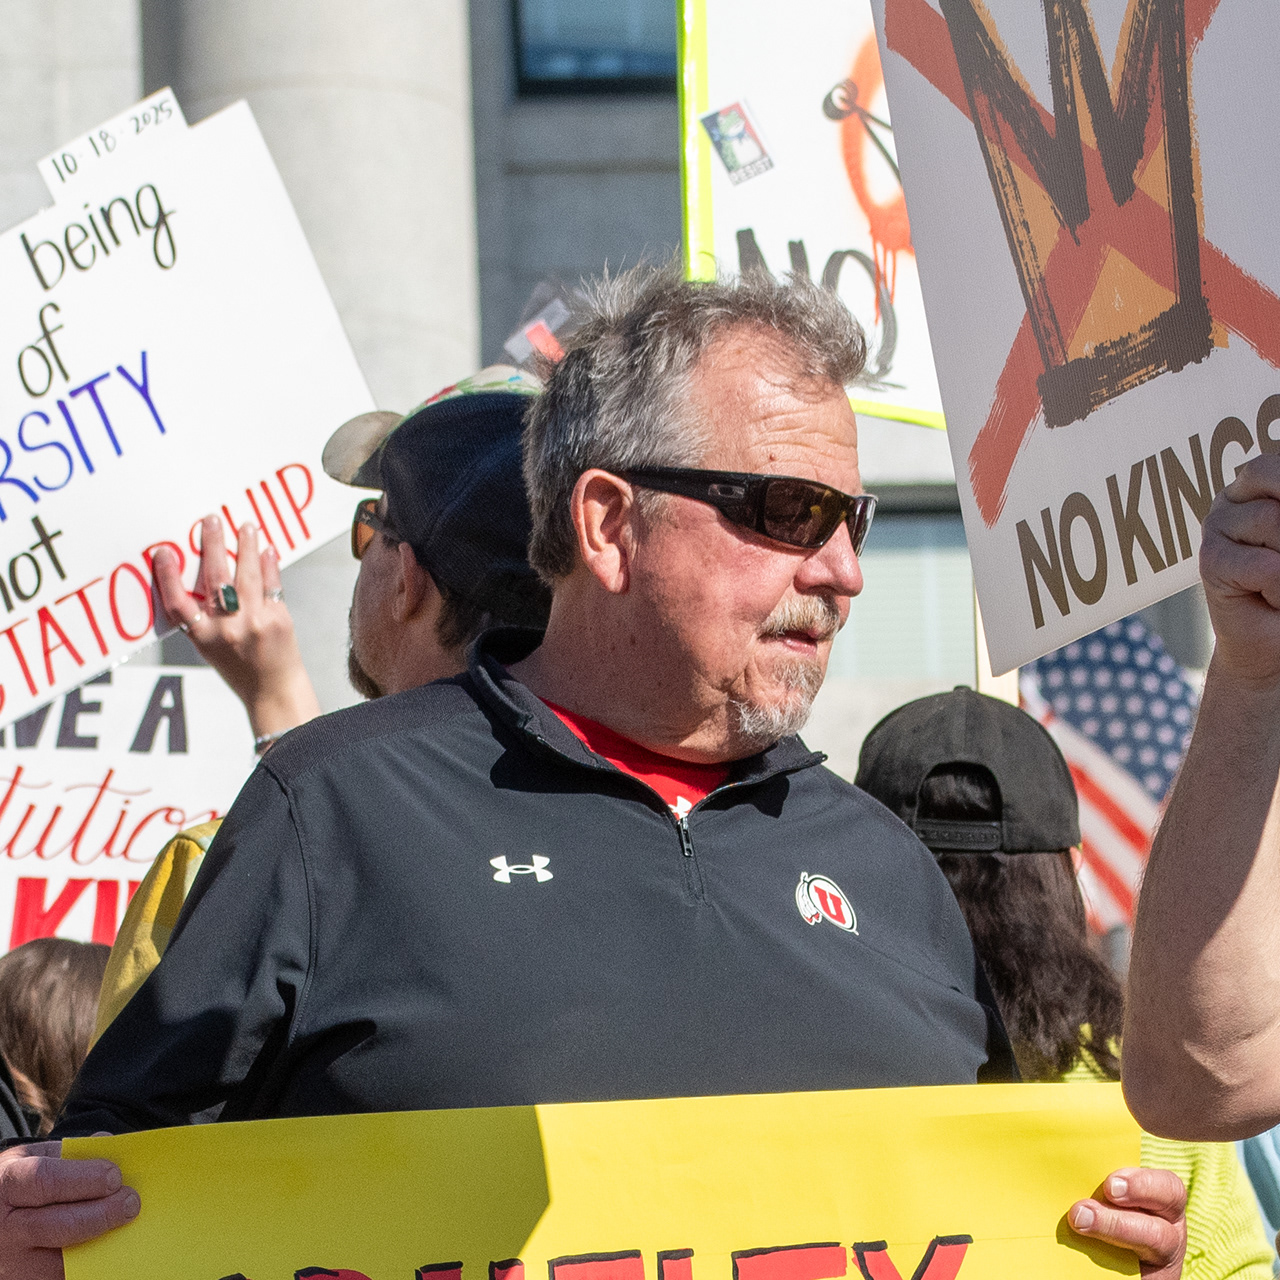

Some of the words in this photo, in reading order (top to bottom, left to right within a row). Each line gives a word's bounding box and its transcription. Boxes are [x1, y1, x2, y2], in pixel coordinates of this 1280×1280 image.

[21, 183, 177, 291] being
[18, 302, 71, 398] of
[1016, 492, 1109, 630] NO
[129, 676, 189, 754] A
